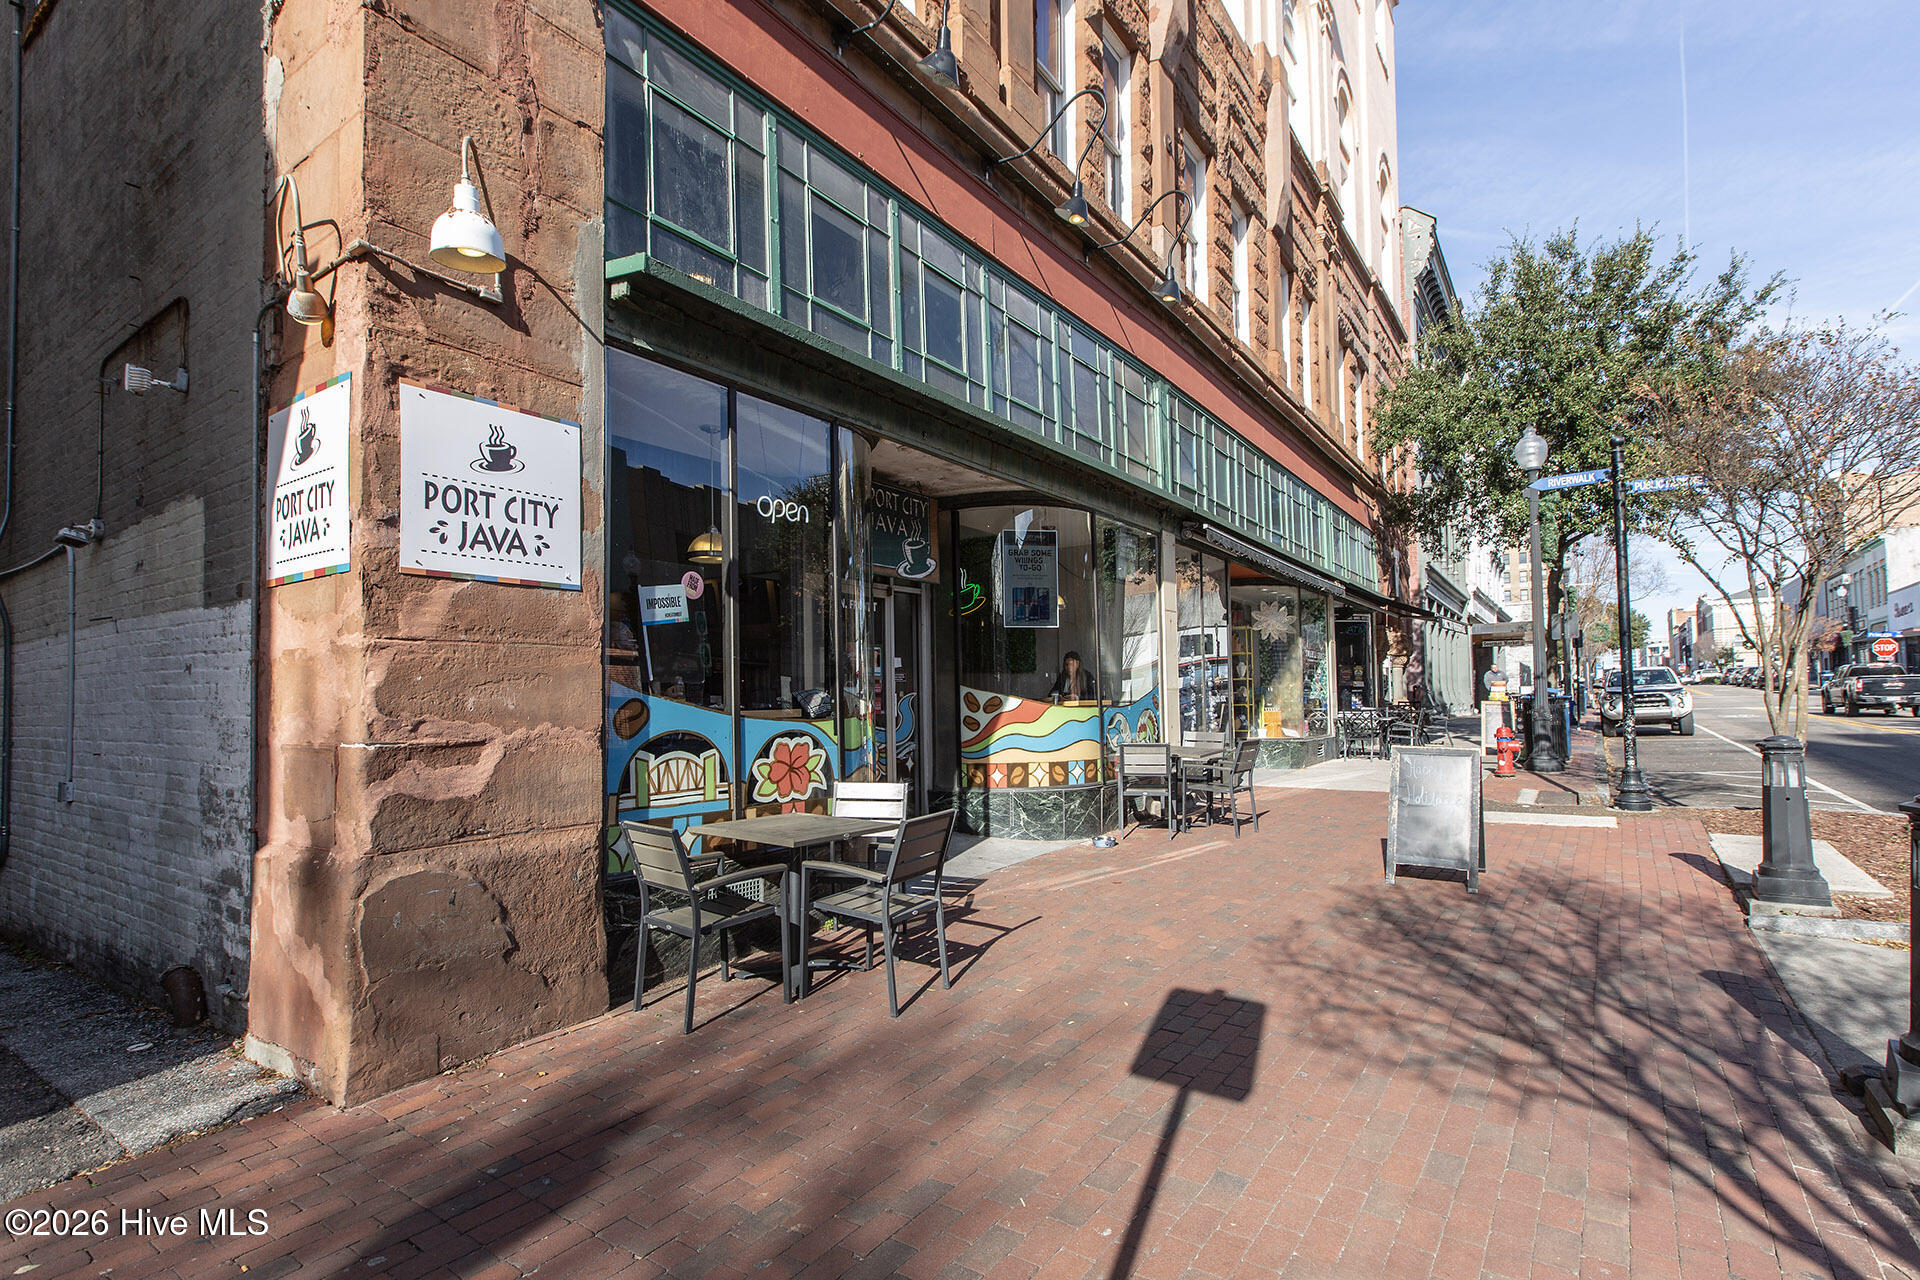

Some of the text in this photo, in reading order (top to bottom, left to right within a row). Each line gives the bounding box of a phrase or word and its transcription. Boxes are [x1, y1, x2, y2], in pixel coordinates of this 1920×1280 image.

[1547, 472, 1596, 488] RIVERWALK
[1634, 479, 1665, 491] PUBLIC
[276, 479, 335, 522] PORT CITY
[424, 480, 560, 530] PORT CITY
[756, 495, 809, 524] Open
[902, 496, 928, 518] CITY
[288, 516, 320, 550] JAVA
[457, 520, 528, 557] JAVA
[1008, 549, 1053, 557] GRAB SOME
[1874, 643, 1896, 652] STOP
